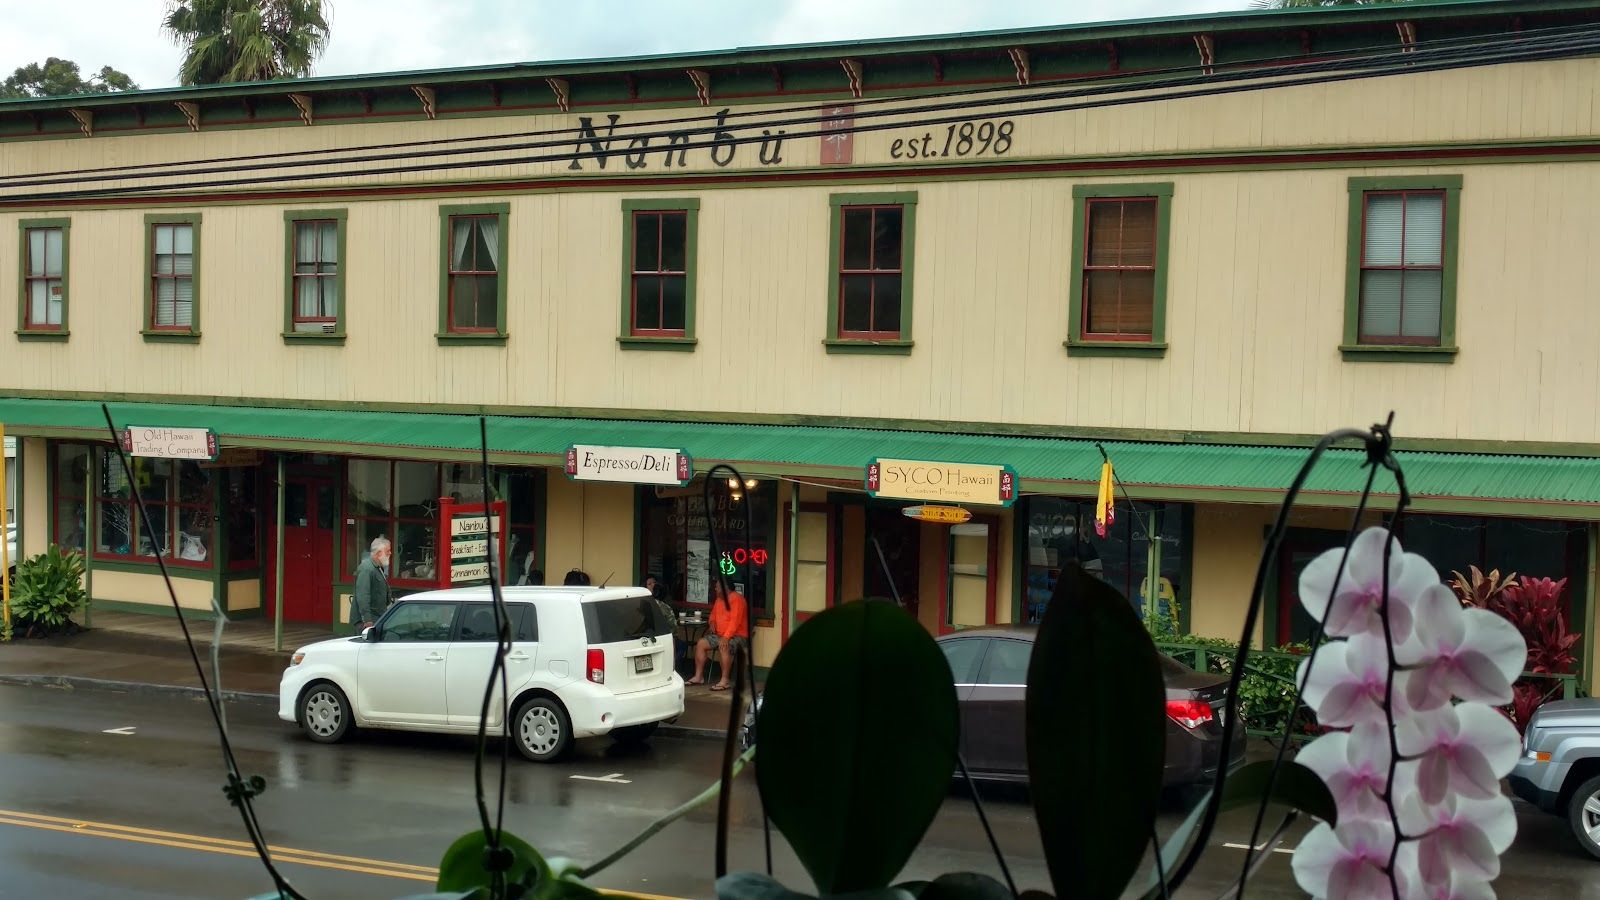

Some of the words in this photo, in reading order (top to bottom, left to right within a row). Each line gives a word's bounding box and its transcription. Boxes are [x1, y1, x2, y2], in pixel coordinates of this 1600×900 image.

[568, 108, 787, 170] Nanbu
[143, 429, 162, 442] Old
[163, 430, 194, 442] Hawaii
[134, 442, 164, 456] Trading
[167, 442, 206, 457] Company
[584, 452, 671, 473] Espresso/Deli
[885, 466, 943, 485] SYCO
[947, 468, 994, 486] Hawaii
